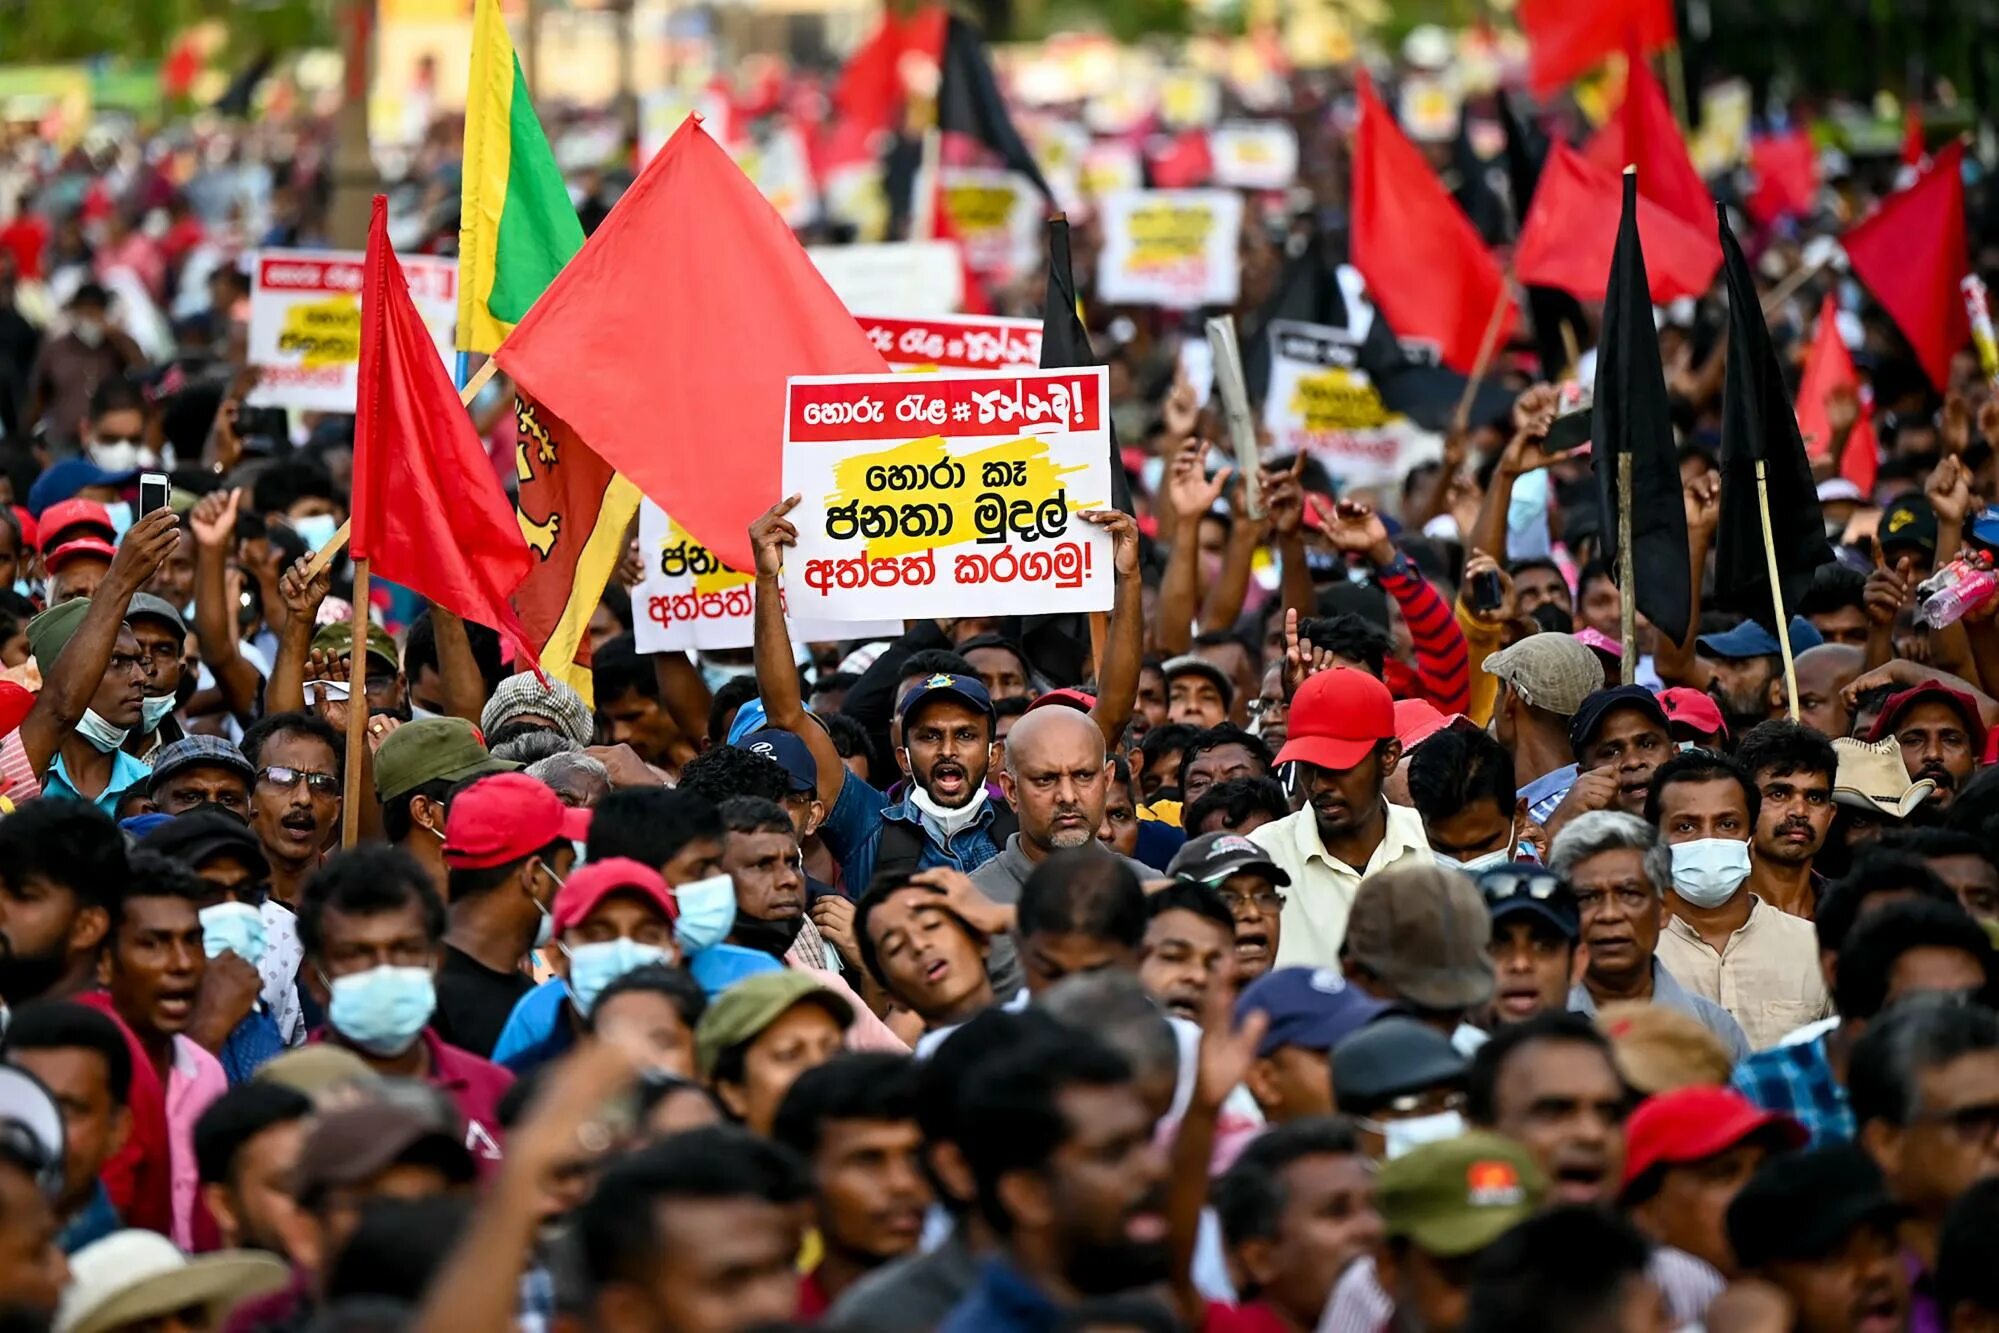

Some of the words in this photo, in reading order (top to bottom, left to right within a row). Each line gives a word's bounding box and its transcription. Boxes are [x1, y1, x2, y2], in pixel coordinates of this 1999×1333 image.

[803, 395, 884, 424] හොරු
[896, 394, 947, 424] රැළ
[866, 456, 965, 491] හොරා
[982, 460, 1027, 487] කෑ
[826, 499, 953, 539] ජනතා
[974, 488, 1067, 544] මුදල්
[804, 548, 935, 596] අත්පත්
[954, 542, 1091, 588] කරගමු!
[648, 582, 752, 629] අත්පත්
